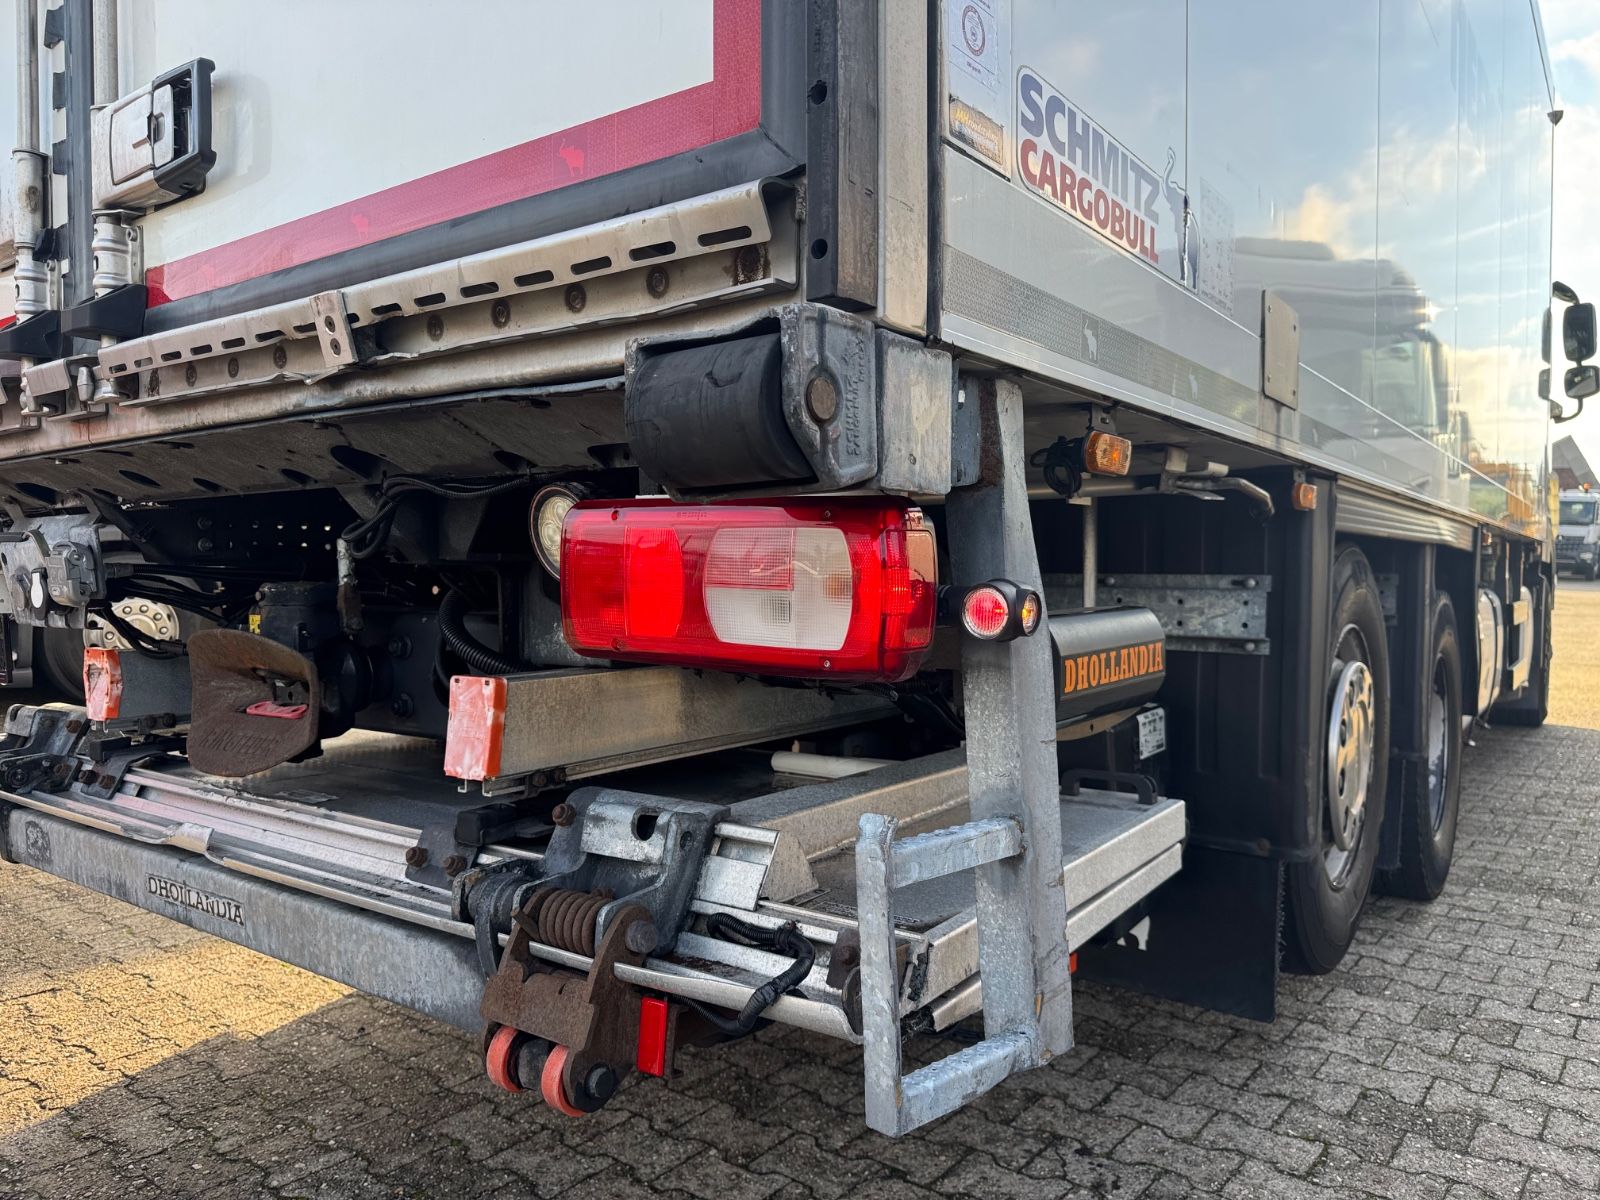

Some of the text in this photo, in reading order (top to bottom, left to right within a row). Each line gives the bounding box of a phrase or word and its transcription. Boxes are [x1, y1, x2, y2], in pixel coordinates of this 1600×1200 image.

[1020, 73, 1159, 225] SCHMITZ
[1020, 138, 1159, 264] CARGOBULL
[1064, 641, 1163, 694] DHOLLANDIA
